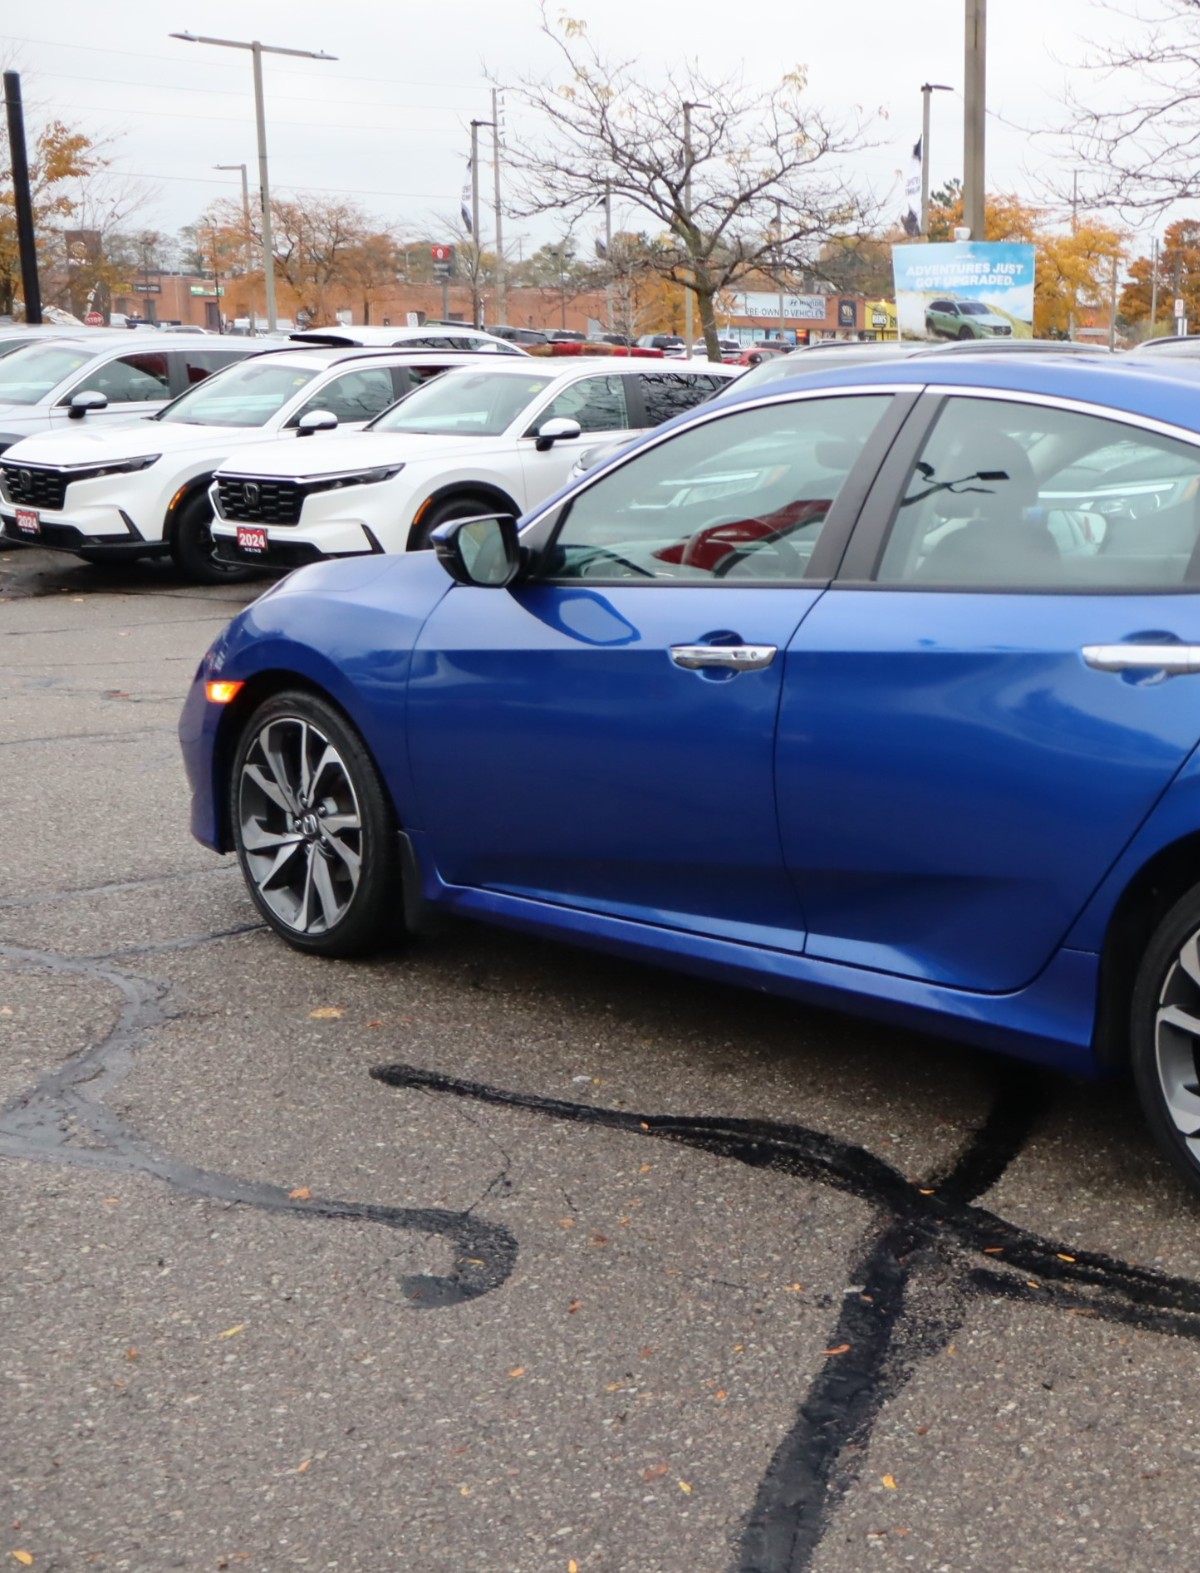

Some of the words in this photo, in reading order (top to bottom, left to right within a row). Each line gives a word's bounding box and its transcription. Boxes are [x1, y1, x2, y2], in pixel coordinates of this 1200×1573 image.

[906, 263, 990, 277] ADVENTURES
[993, 263, 1024, 275] JUST
[916, 276, 943, 288] GOT
[944, 275, 1015, 287] UPGRADED.
[745, 307, 789, 317] PRE-OWND
[17, 514, 38, 530] 2024
[240, 532, 266, 548] 2024
